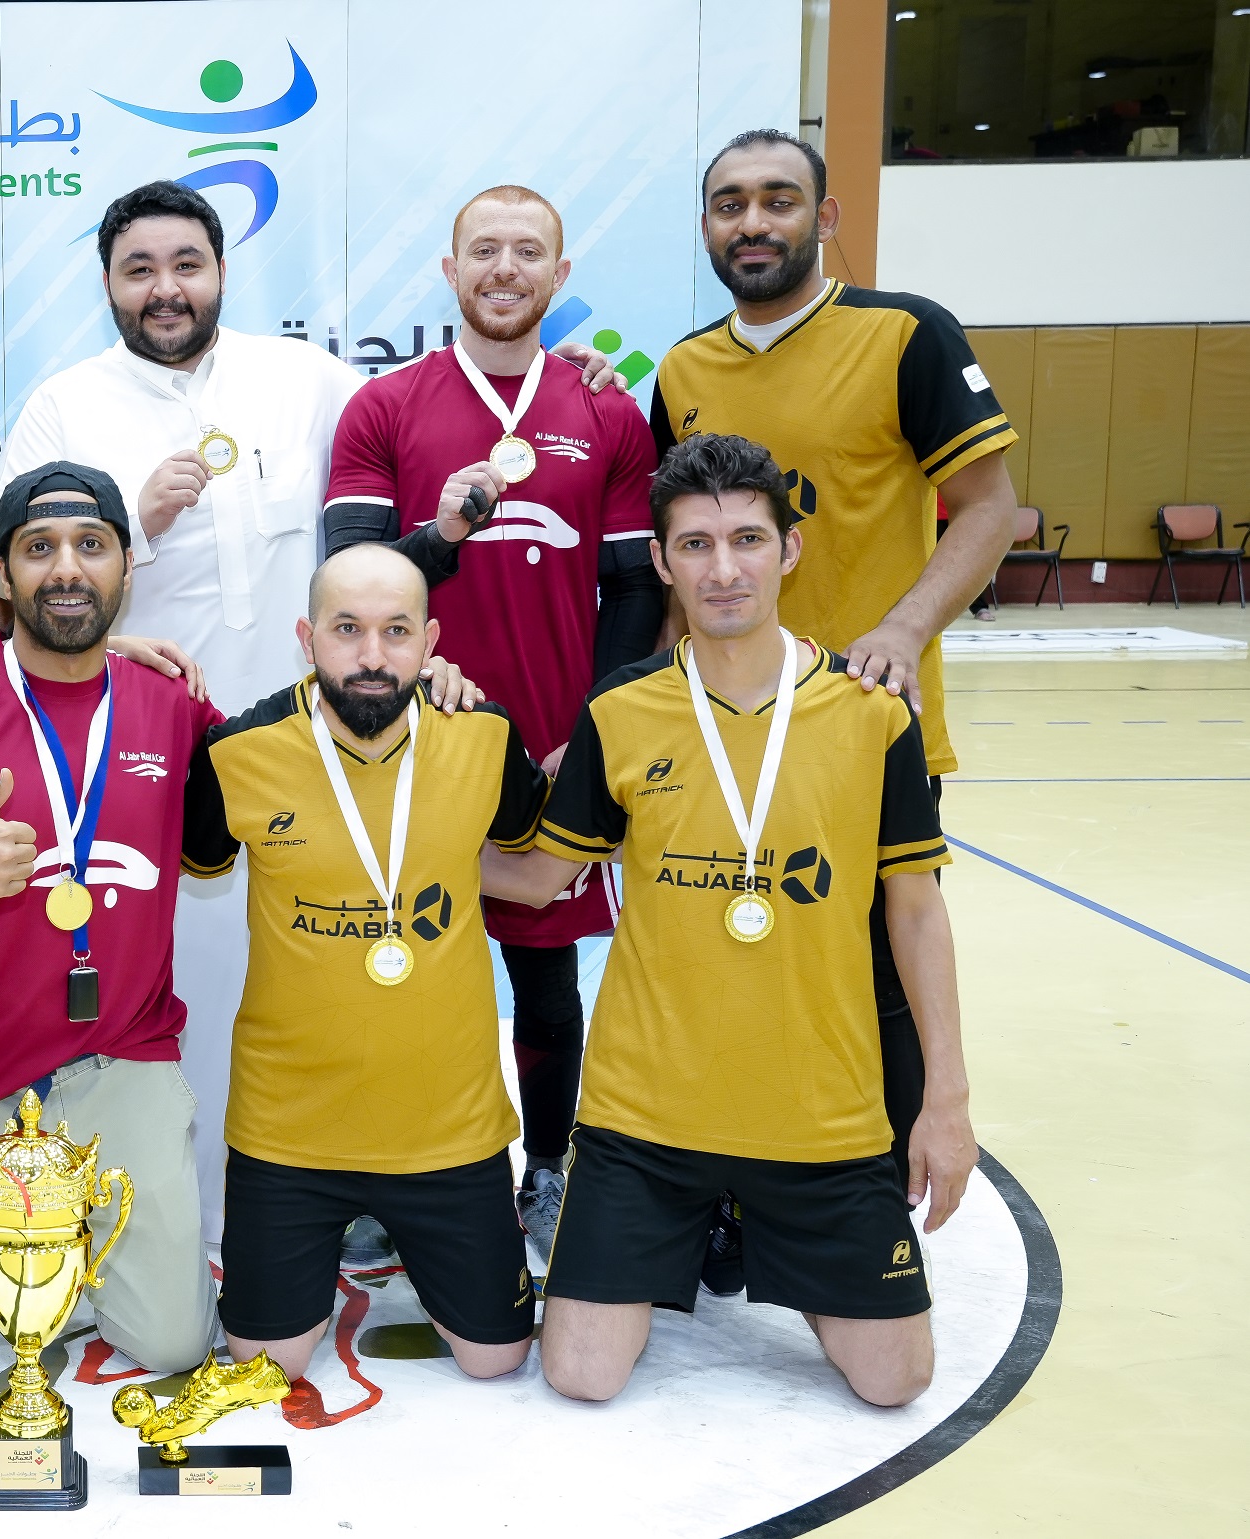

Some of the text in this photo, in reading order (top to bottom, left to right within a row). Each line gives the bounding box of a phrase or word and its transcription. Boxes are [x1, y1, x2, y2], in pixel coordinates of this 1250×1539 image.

[635, 783, 684, 797] HATTRICK
[260, 838, 307, 848] HATTRICK
[655, 867, 772, 895] ALJABR
[294, 892, 403, 919] الجبر
[291, 913, 403, 939] ALJABR
[882, 1266, 920, 1280] HATTRICK
